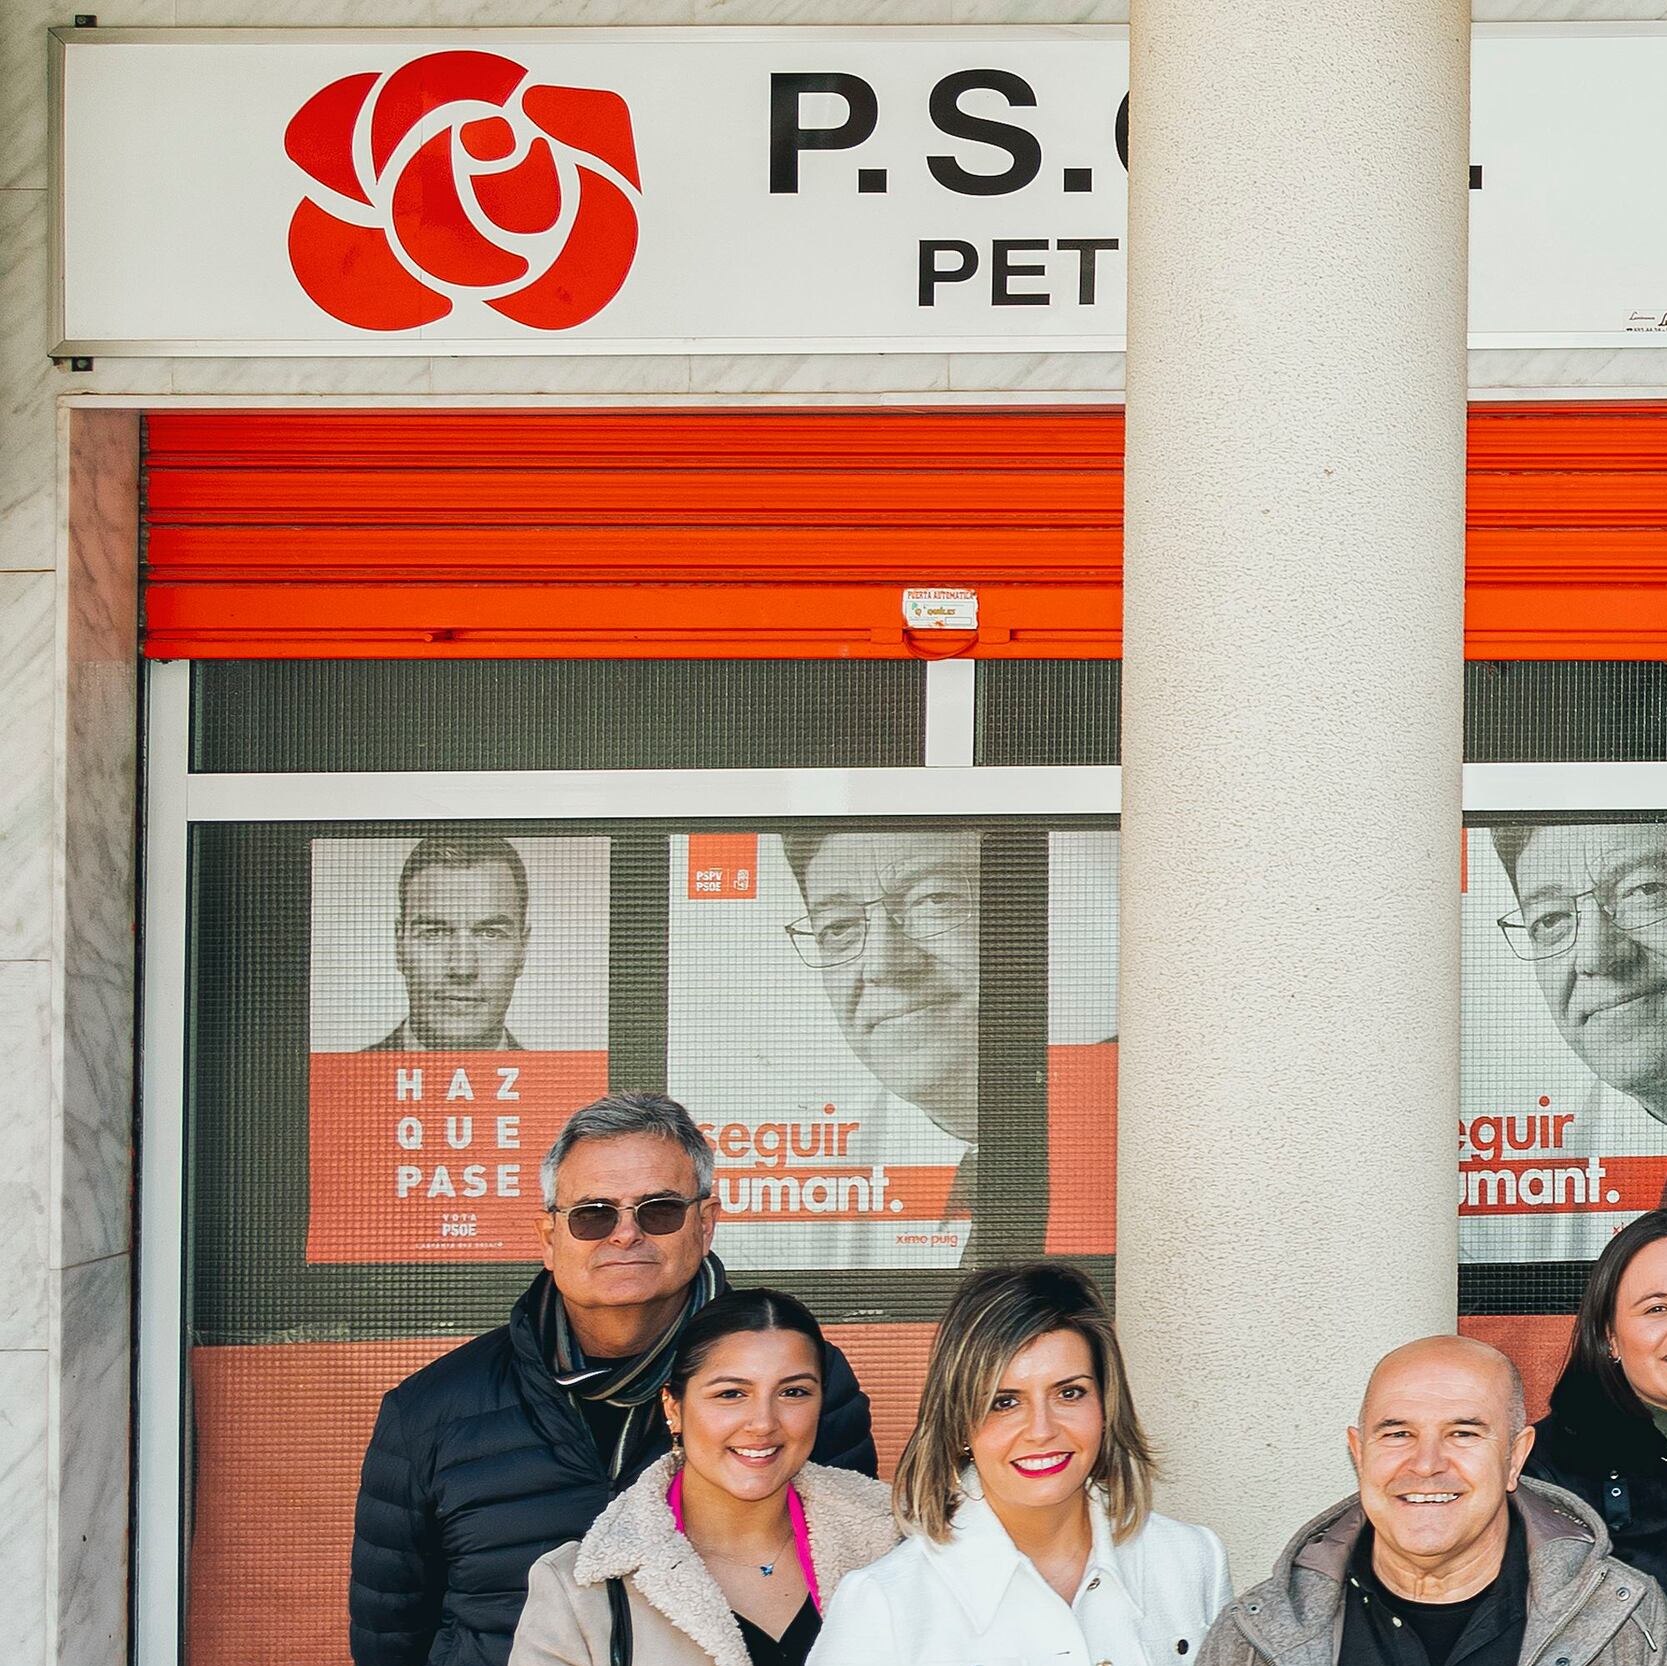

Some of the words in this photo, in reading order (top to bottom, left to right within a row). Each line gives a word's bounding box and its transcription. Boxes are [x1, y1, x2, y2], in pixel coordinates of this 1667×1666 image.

[696, 882, 722, 892] PSOE
[397, 1067, 521, 1101] HAZ
[397, 1115, 521, 1151] QUE
[397, 1164, 521, 1198] PASE
[715, 1165, 904, 1214] umant.
[441, 1223, 478, 1237] PSOE
[895, 1233, 929, 1245] ximo
[930, 1232, 959, 1248] puig
